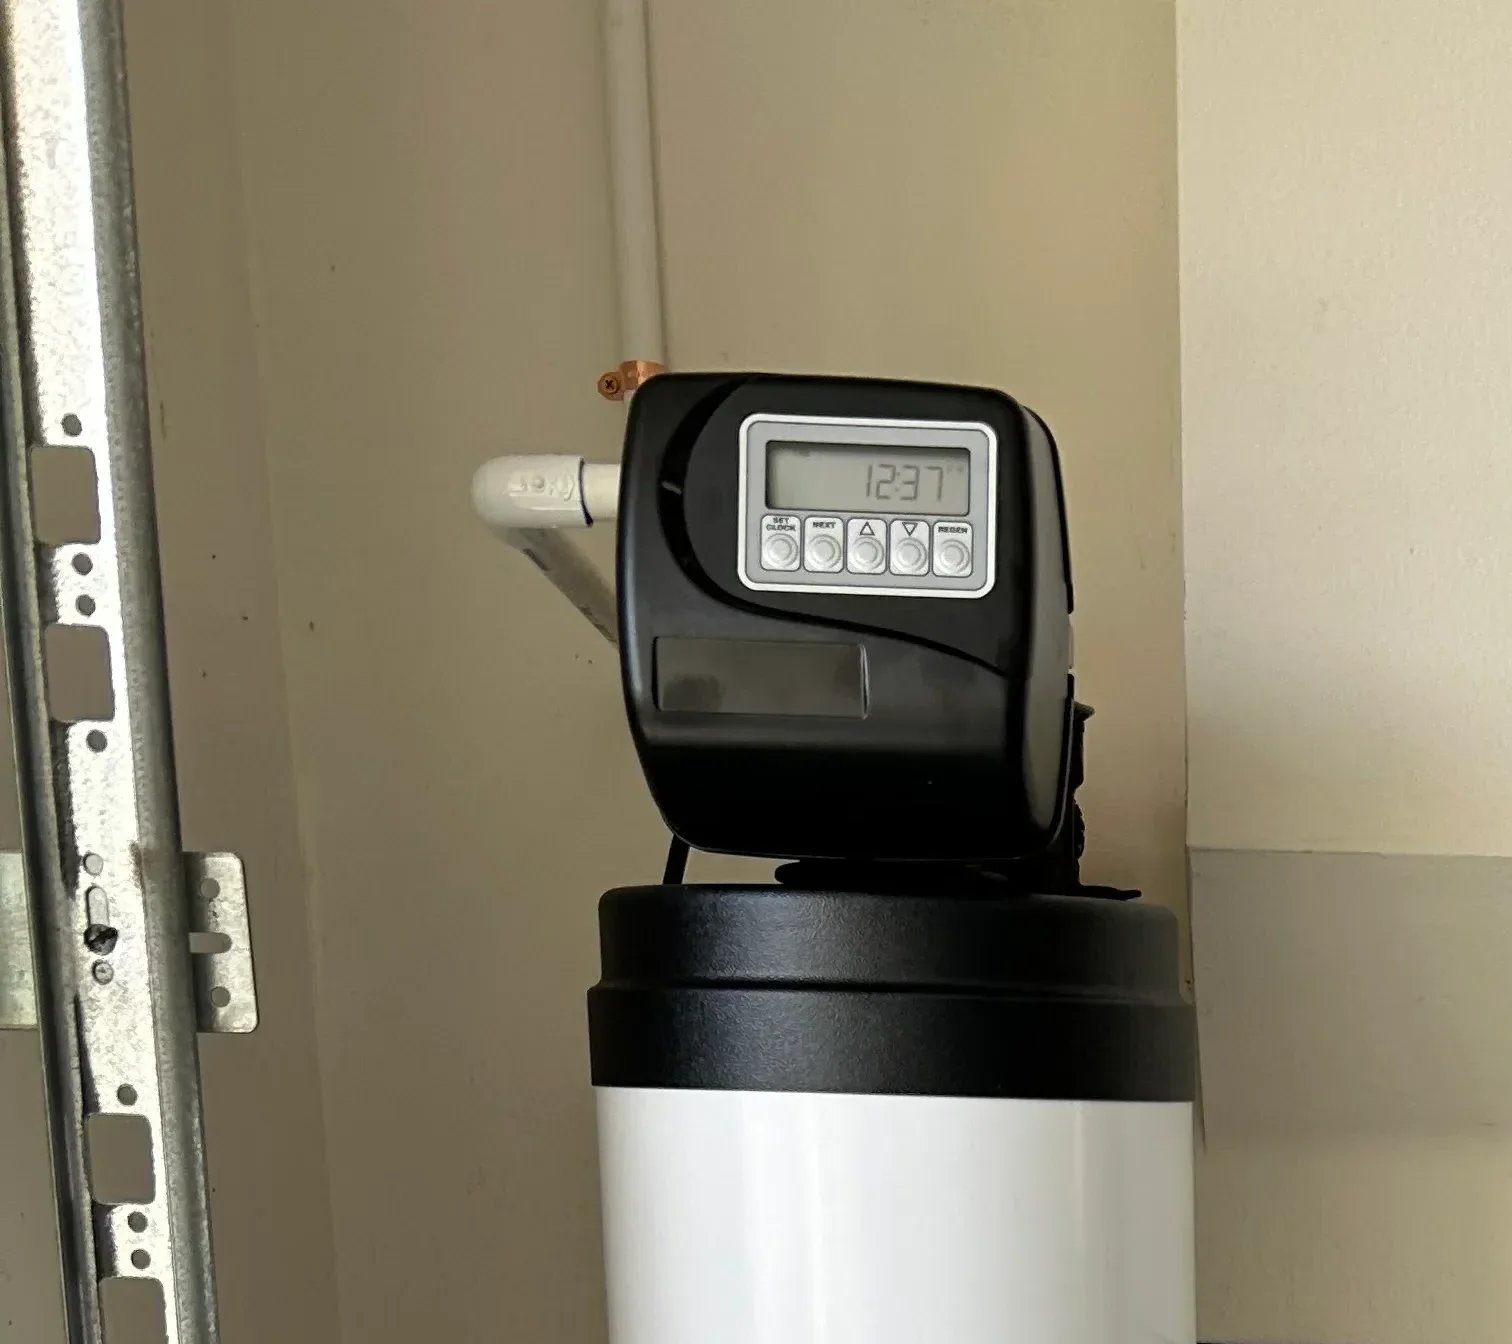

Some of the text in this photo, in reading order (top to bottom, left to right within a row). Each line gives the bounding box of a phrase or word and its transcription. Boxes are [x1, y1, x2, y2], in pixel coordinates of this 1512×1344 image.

[866, 464, 943, 502] 12:37
[766, 524, 797, 532] CLOCK
[812, 521, 837, 529] NEXT
[937, 526, 969, 534] REGEN
